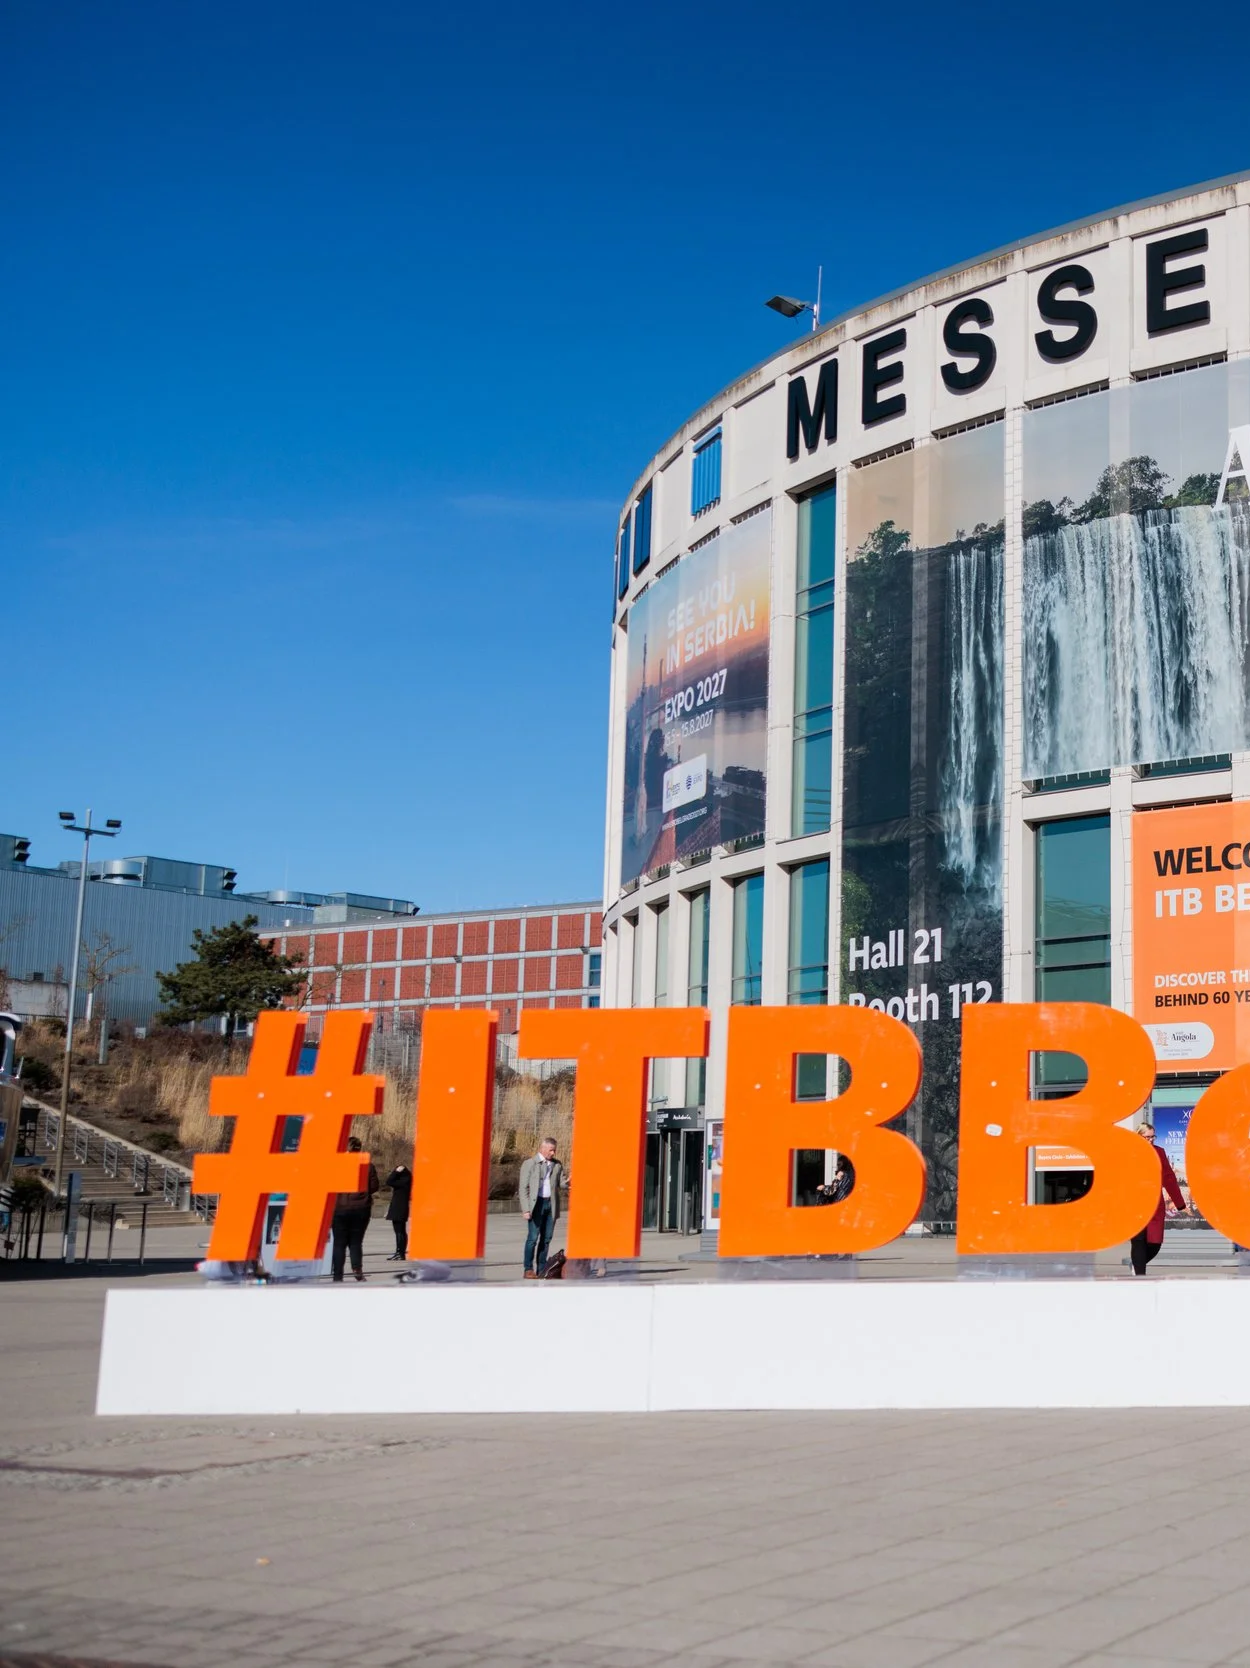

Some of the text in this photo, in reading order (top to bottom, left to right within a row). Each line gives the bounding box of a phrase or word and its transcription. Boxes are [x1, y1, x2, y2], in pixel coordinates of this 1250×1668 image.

[786, 227, 1211, 459] MESSE
[667, 571, 736, 639] SEE YOU
[666, 639, 681, 675] IN
[665, 668, 728, 724] EXPO 2027
[1155, 888, 1203, 918] ITB
[849, 928, 942, 972] Hall 21
[1154, 971, 1226, 988] DISCOVER
[1155, 992, 1208, 1008] BEHIND
[1213, 991, 1231, 1004] 60
[1171, 1033, 1196, 1042] Angola
